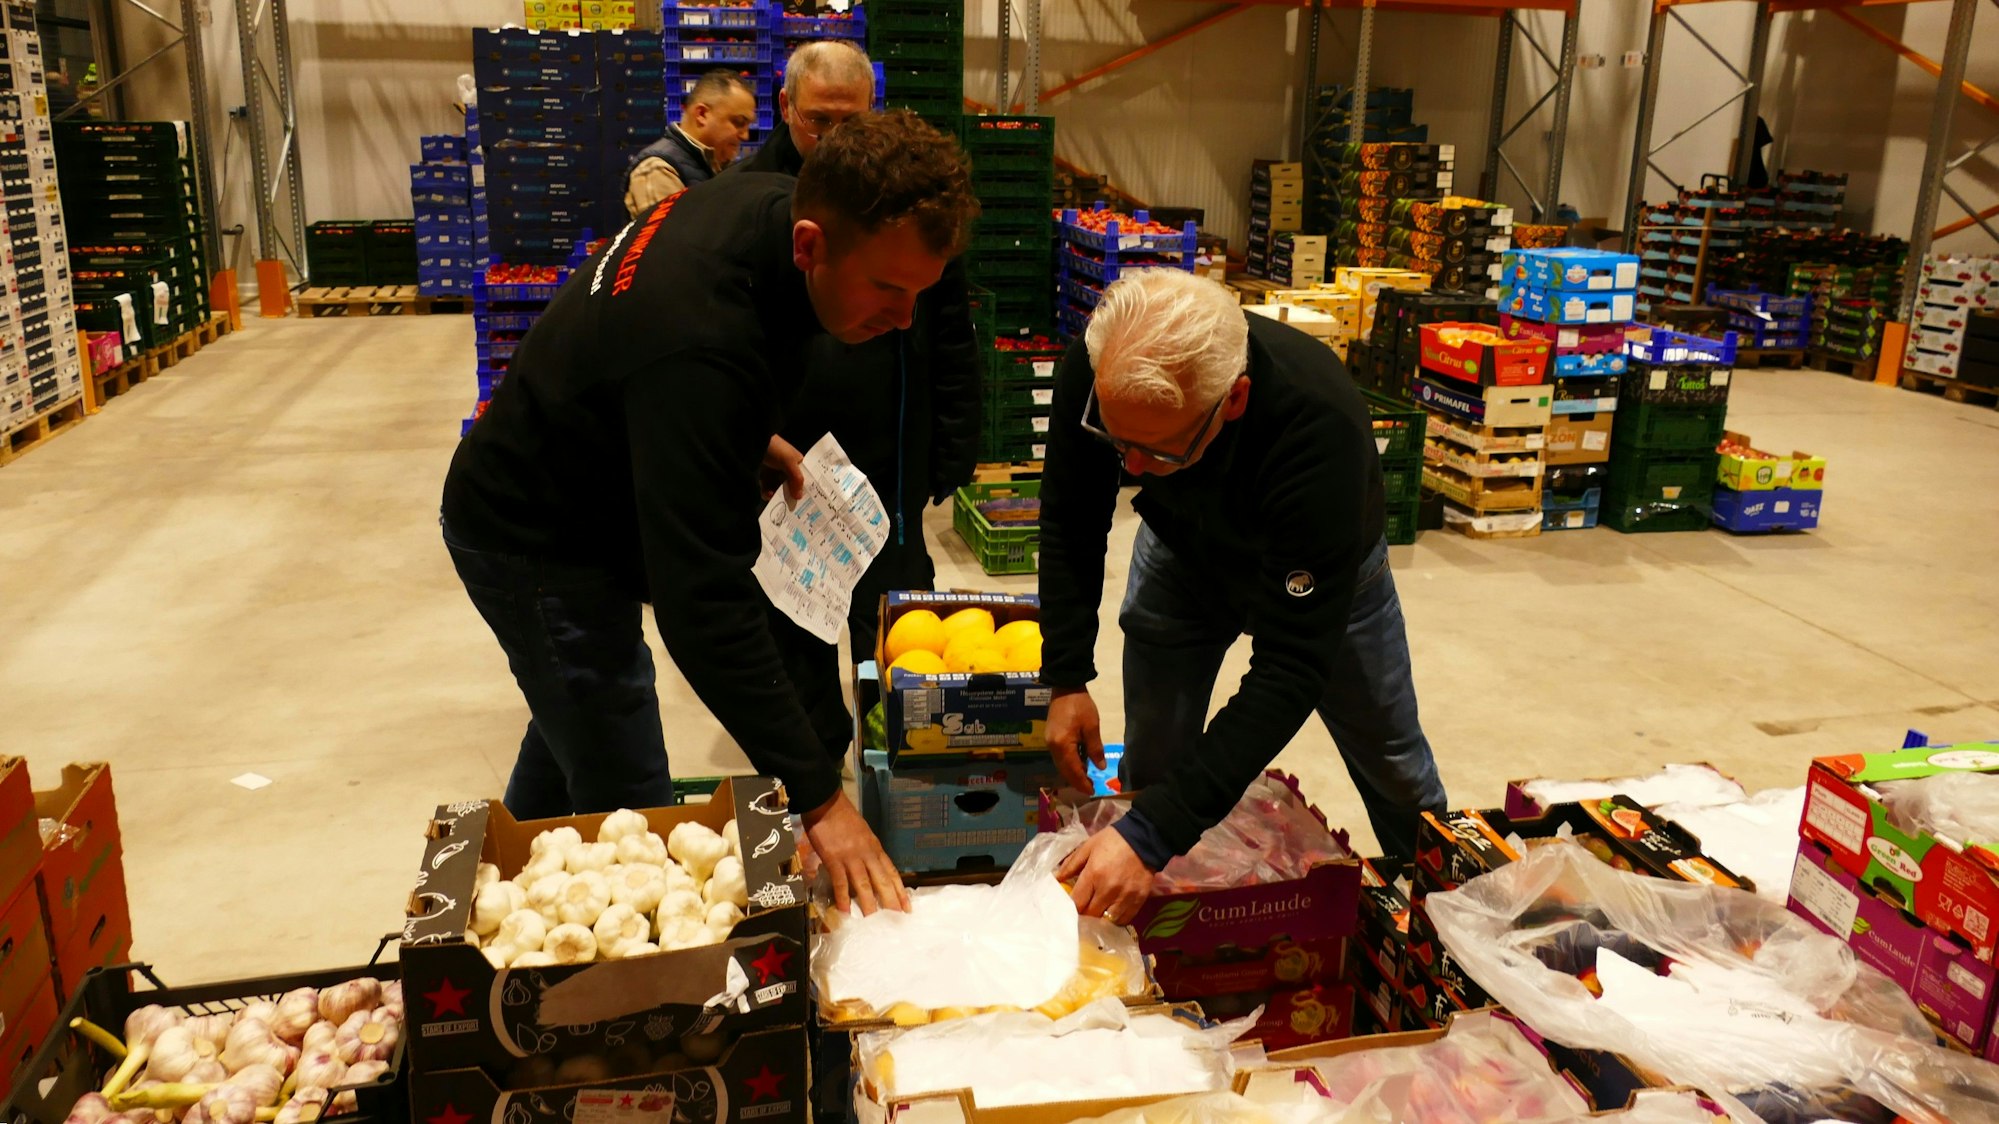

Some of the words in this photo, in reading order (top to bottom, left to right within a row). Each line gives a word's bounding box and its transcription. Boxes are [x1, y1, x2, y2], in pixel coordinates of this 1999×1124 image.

[1433, 392, 1471, 413] PRIMAFEL
[942, 712, 986, 735] Sab
[1870, 843, 1897, 865] Green
[1899, 862, 1917, 878] Red
[1199, 905, 1246, 923] Cum
[1251, 893, 1311, 916] Laude
[1868, 930, 1889, 949] Cum
[1888, 943, 1915, 968] Laude
[1257, 1019, 1284, 1029] Group
